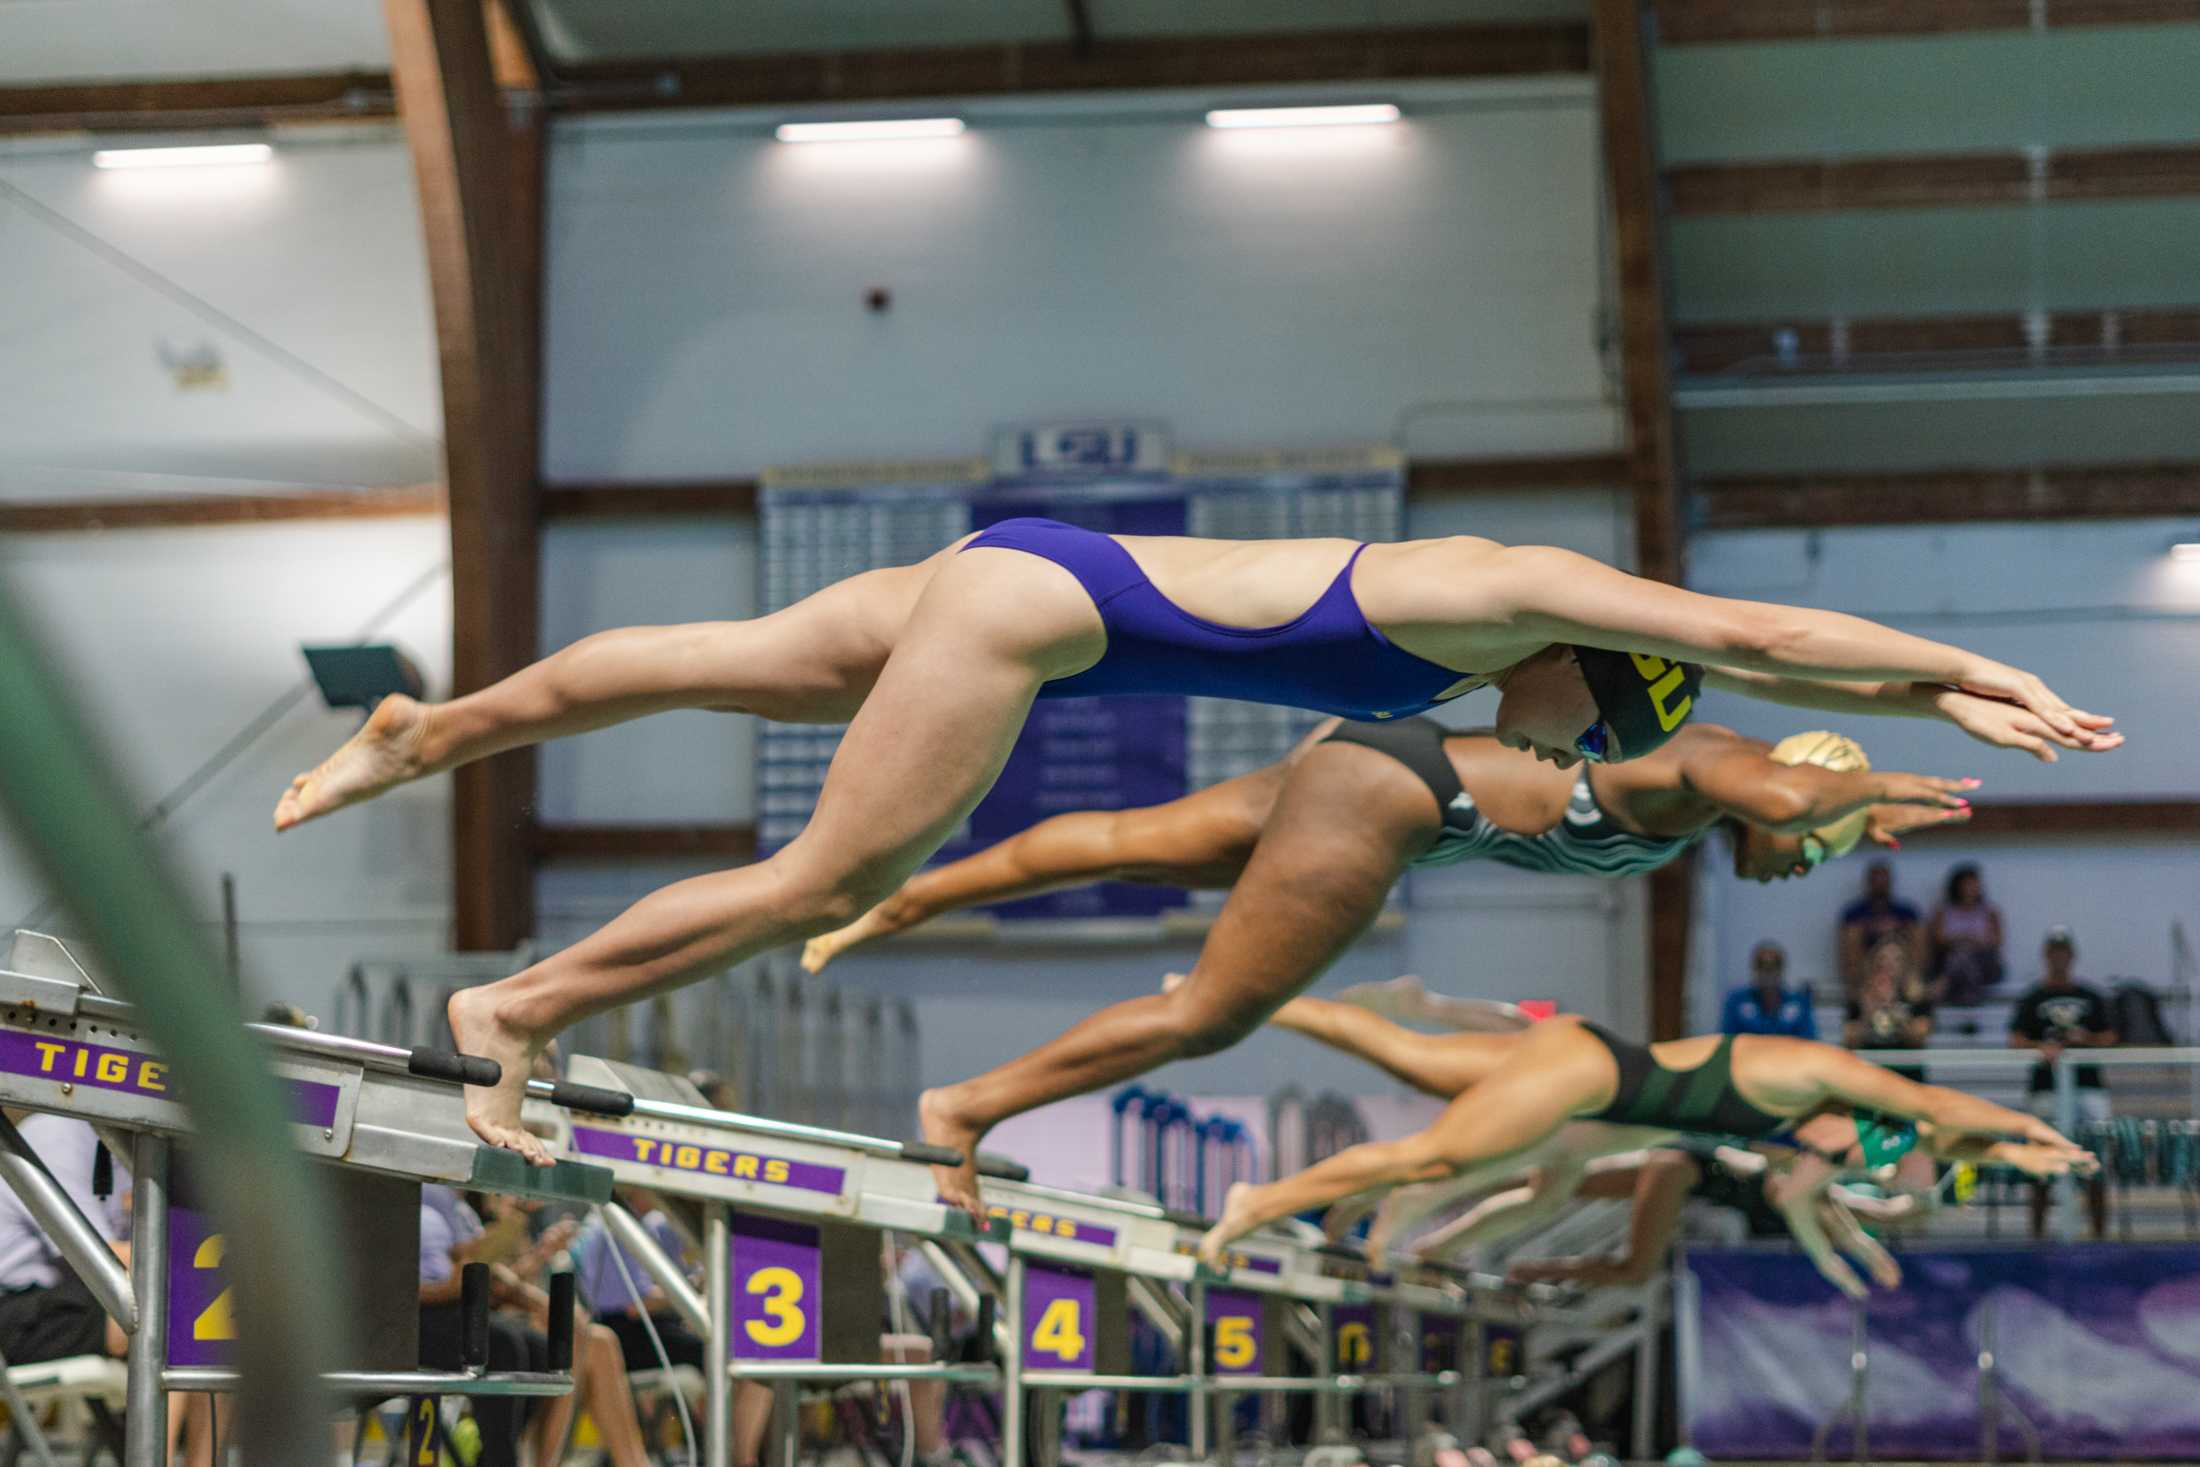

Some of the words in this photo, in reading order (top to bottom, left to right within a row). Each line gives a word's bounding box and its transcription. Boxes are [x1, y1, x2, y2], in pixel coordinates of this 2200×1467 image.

[632, 1137, 791, 1184] TIGERS
[744, 1266, 806, 1348] 3
[1032, 1299, 1085, 1361] 4
[1215, 1316, 1256, 1368] 5
[418, 1398, 434, 1466] 2
